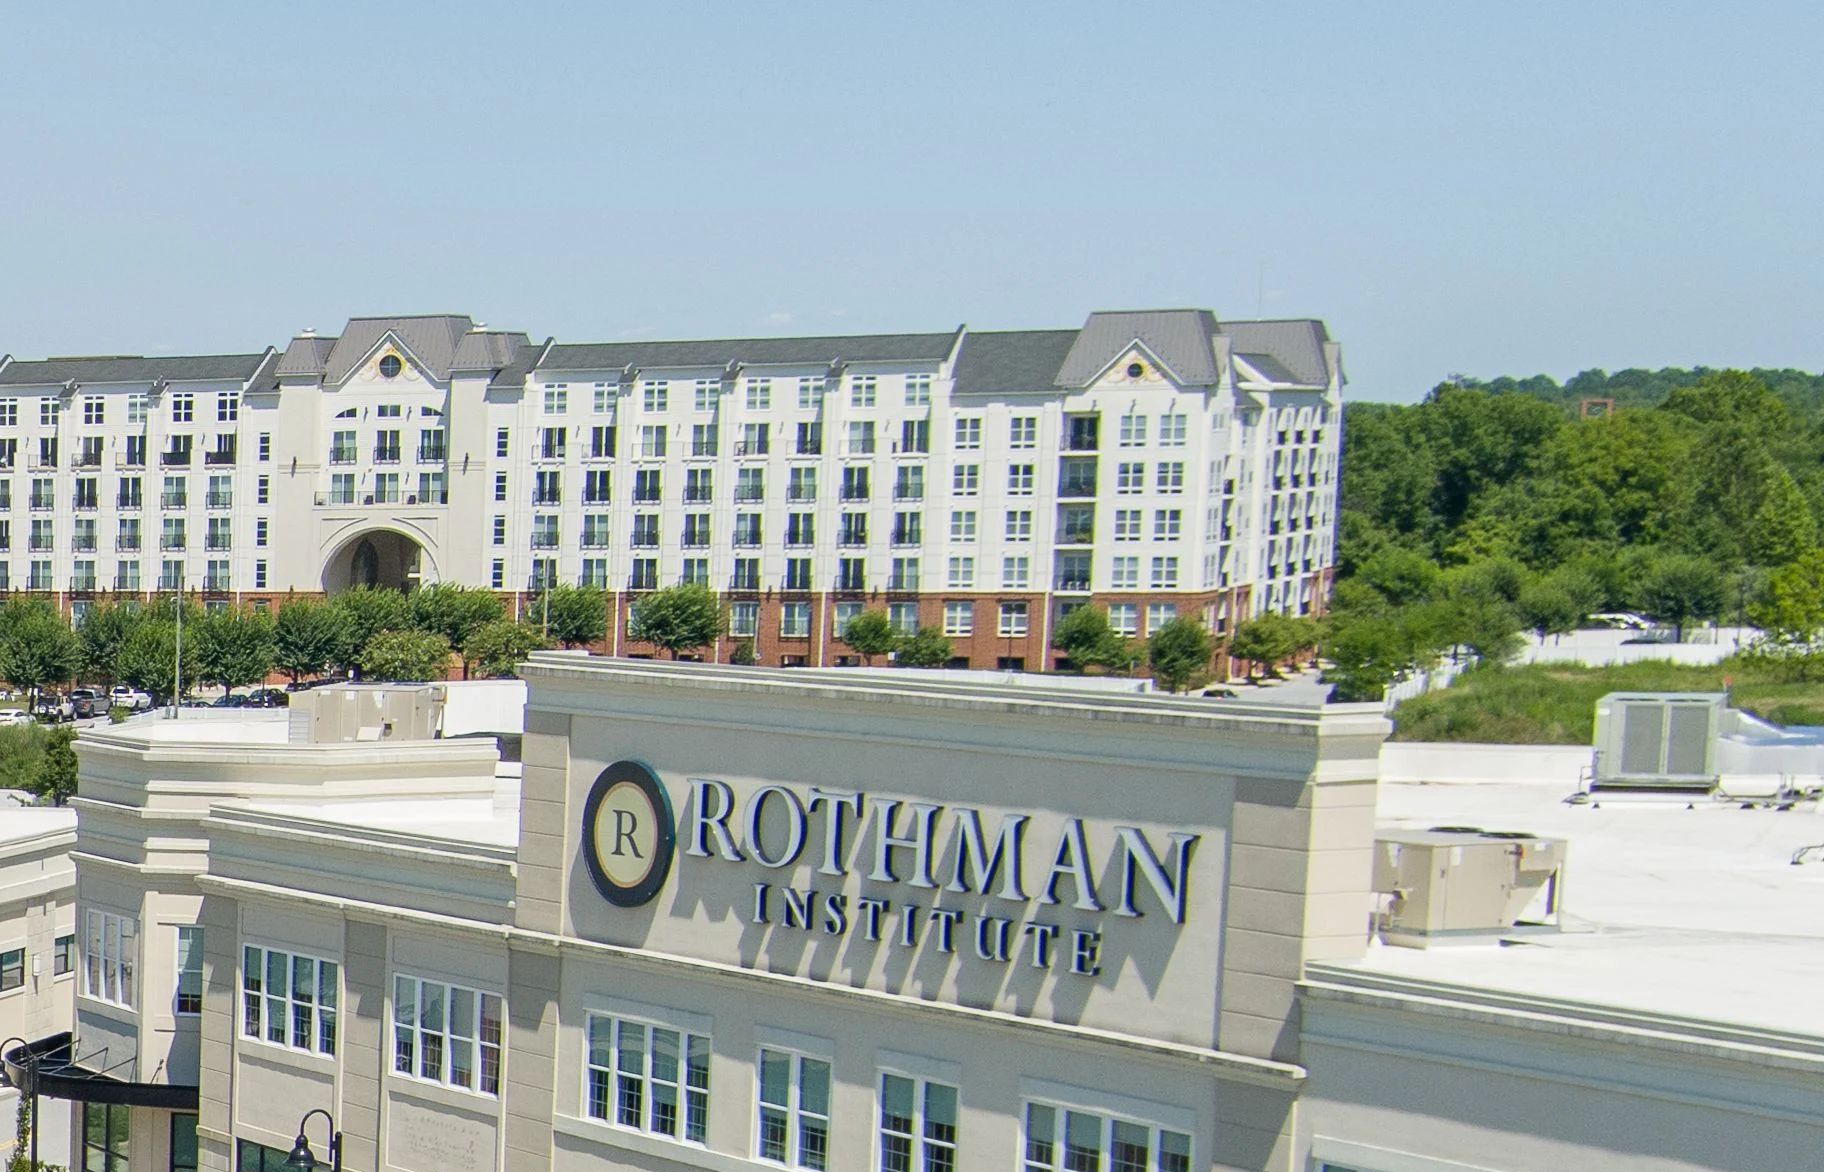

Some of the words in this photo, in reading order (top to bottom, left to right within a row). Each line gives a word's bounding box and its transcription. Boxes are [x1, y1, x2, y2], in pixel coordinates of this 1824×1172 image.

[611, 809, 644, 859] R
[685, 778, 1200, 924] ROTHMAN
[752, 883, 1103, 976] INSTITUTE
